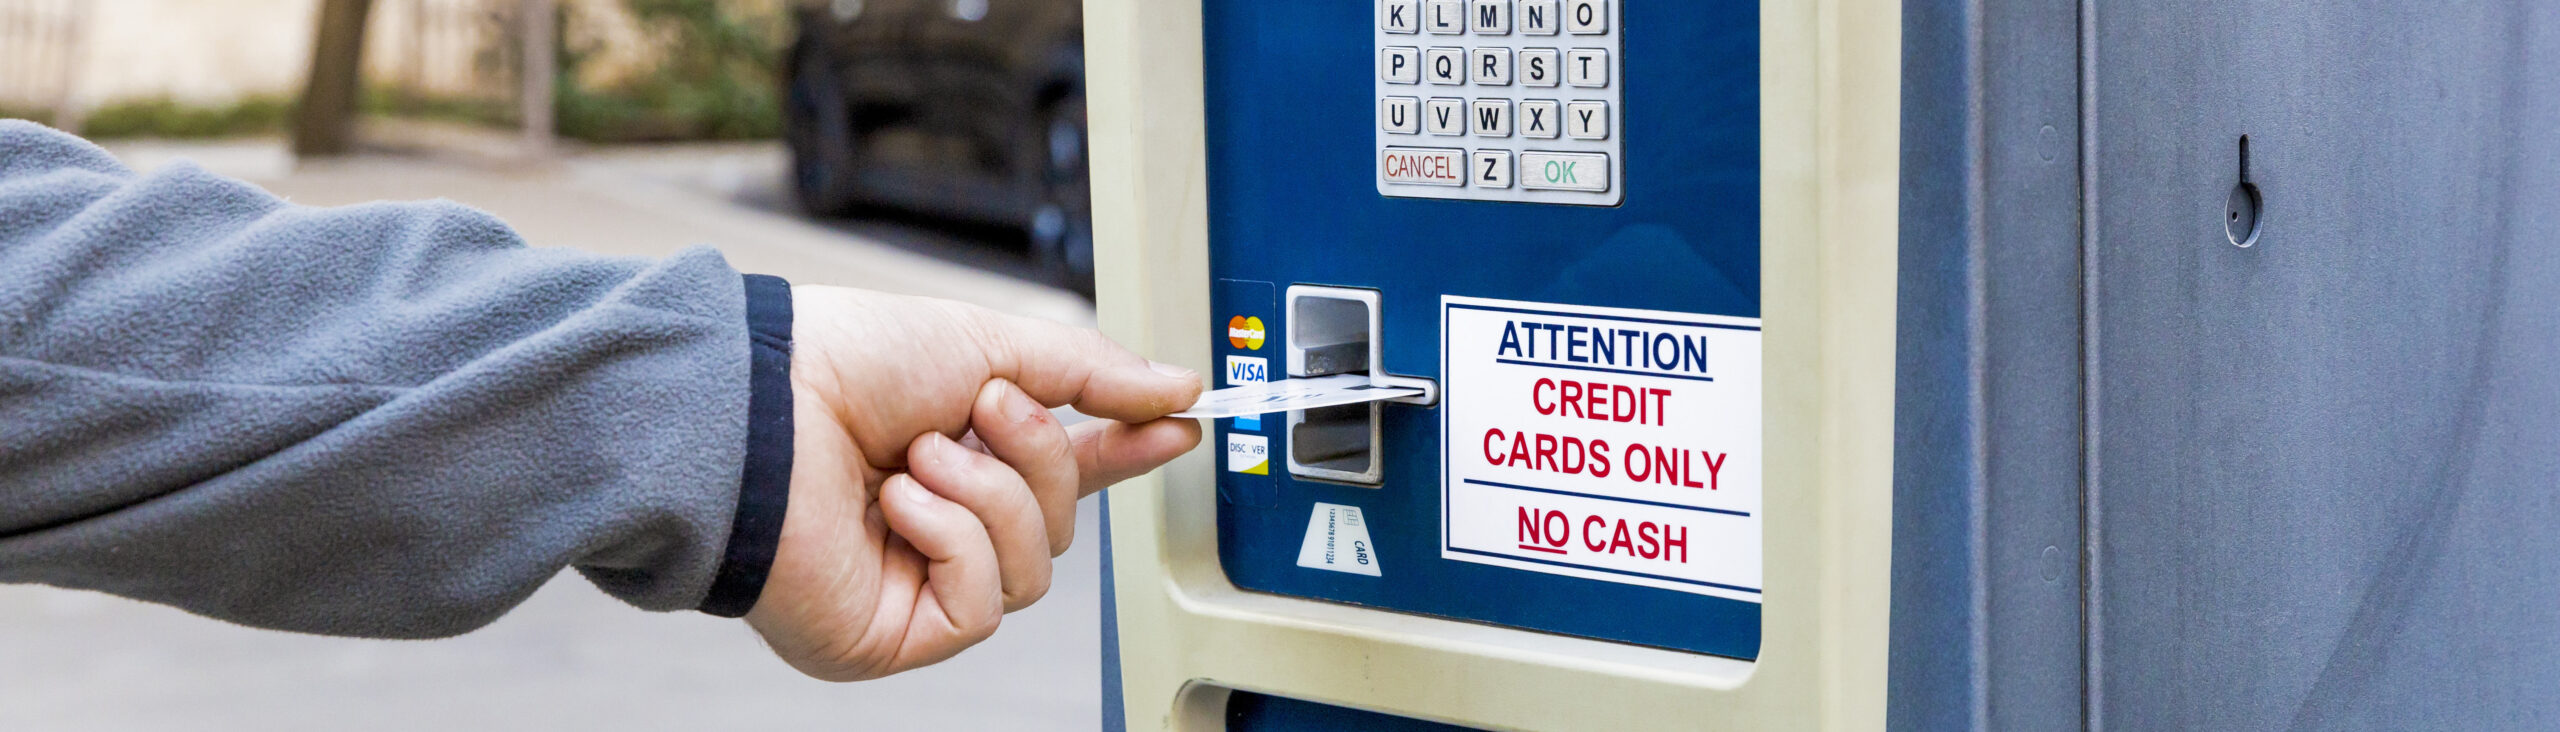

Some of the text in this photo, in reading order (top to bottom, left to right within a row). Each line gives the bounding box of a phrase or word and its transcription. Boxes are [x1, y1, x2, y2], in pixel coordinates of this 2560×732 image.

[1390, 3, 1593, 29] K L M N O
[1392, 53, 1592, 81] P Q R S T
[1391, 103, 1593, 133] U V W X Y
[1386, 154, 1577, 183] CANCEL Z OK
[1498, 320, 1707, 373] ATTENTION
[1231, 361, 1265, 382] VISA
[1533, 378, 1671, 426] CREDIT
[1230, 442, 1265, 455] DISCVER
[1484, 428, 1727, 490] CARDS ONLY
[1518, 506, 1687, 563] NO CASH
[1354, 540, 1369, 565] CARD
